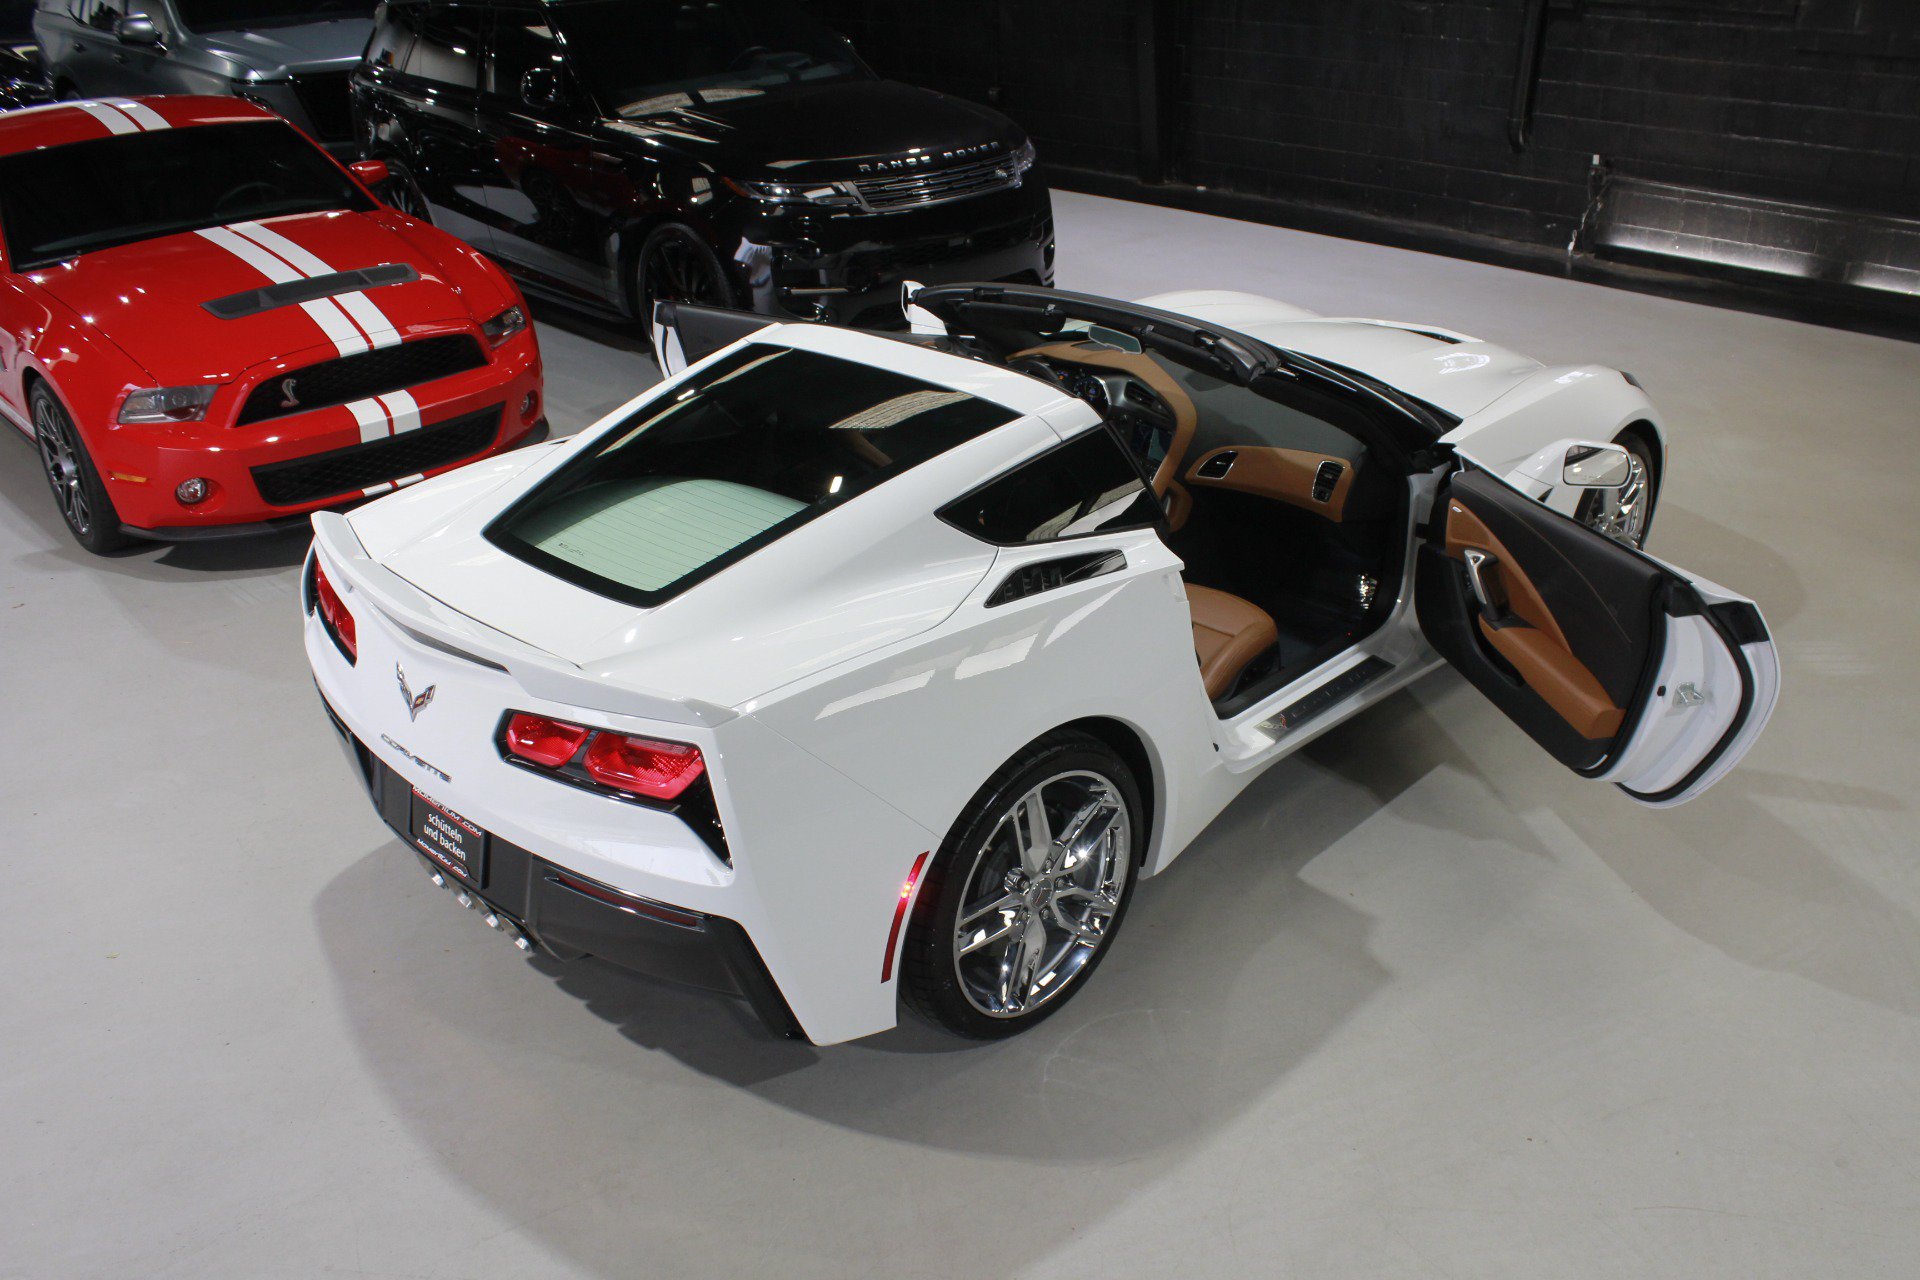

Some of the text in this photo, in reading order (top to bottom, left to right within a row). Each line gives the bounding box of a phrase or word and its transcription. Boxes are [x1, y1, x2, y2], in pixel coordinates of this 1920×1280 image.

[859, 141, 999, 172] RANGE ROVER
[381, 732, 452, 784] CORVETTE
[423, 824, 466, 862] und backen
[427, 813, 463, 844] schütteln
